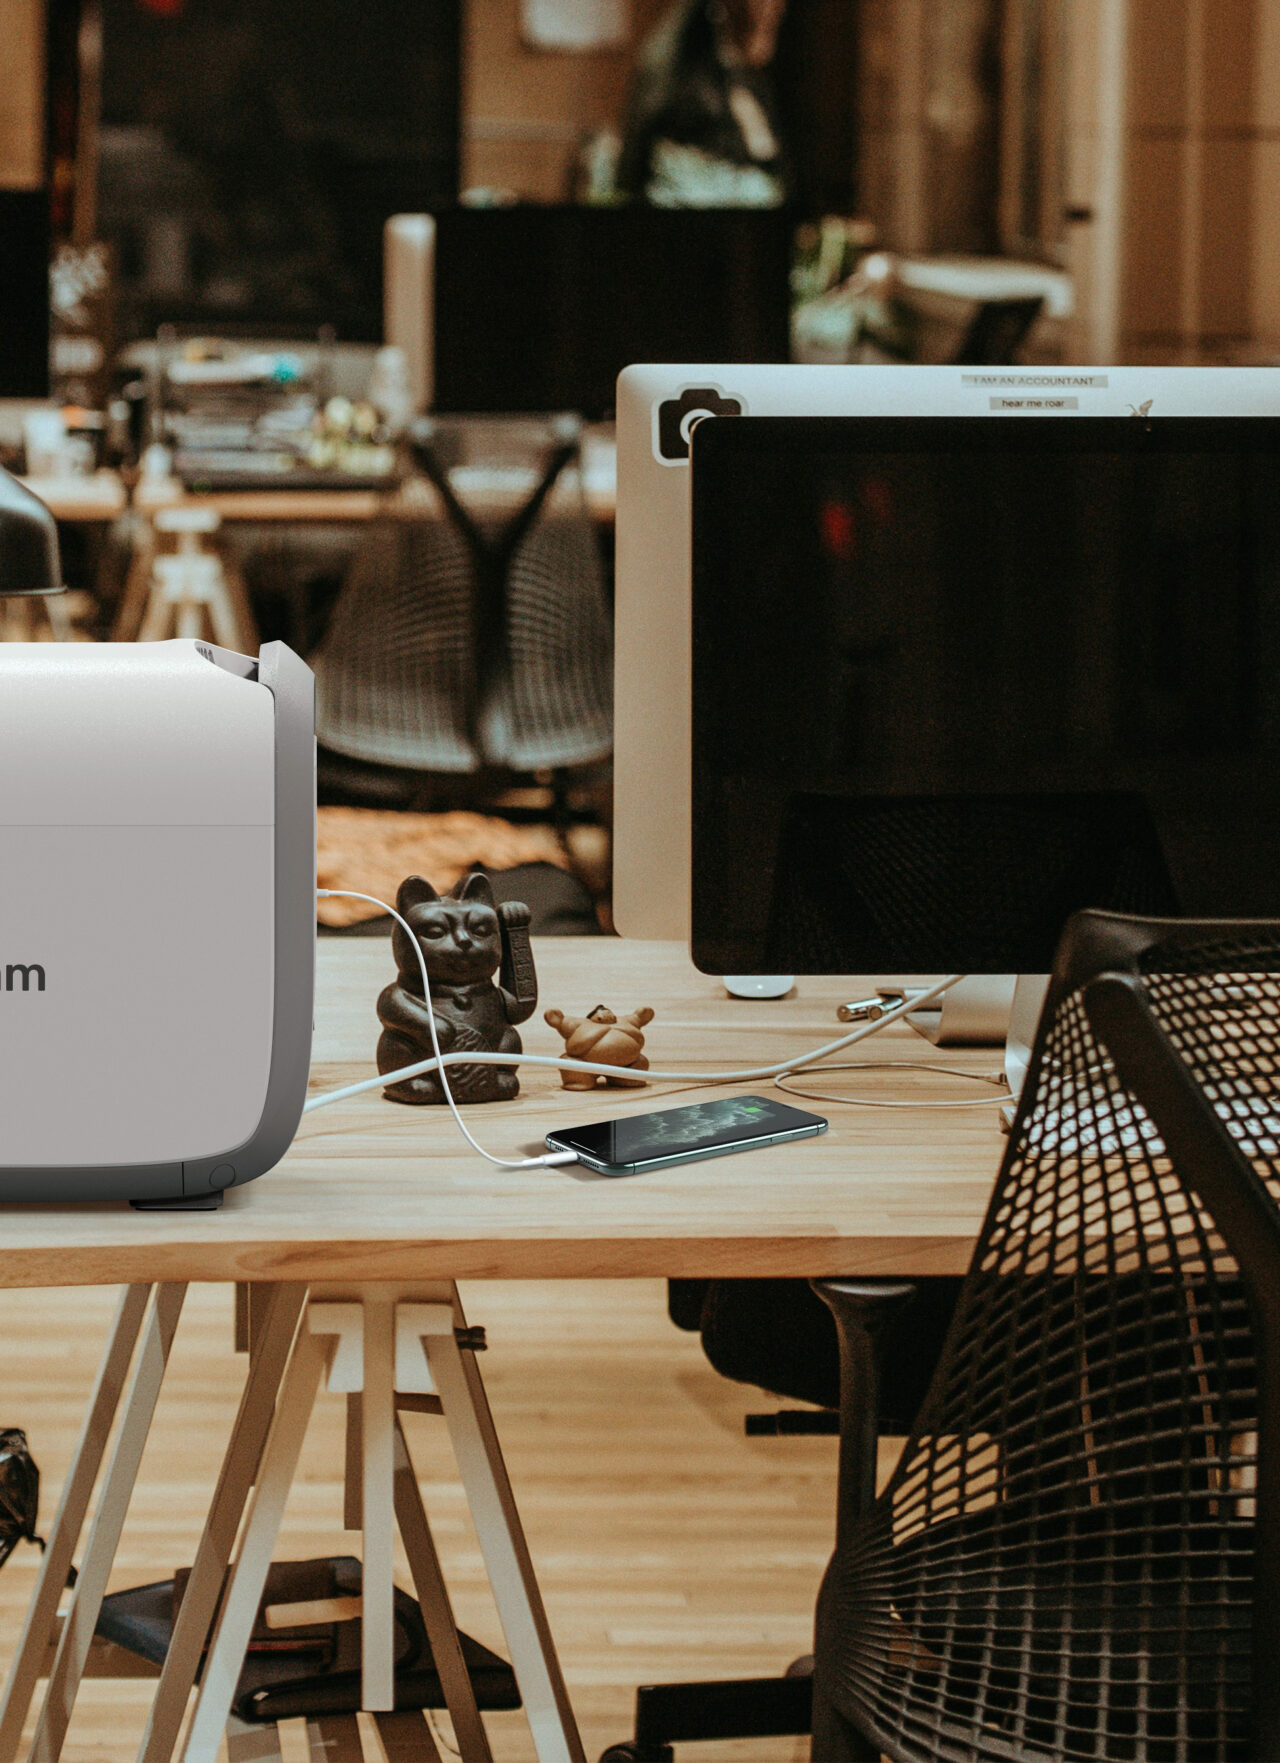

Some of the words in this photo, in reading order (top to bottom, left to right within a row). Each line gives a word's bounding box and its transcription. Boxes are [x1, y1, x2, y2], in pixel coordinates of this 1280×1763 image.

[999, 377, 1015, 385] AN
[1018, 377, 1095, 386] ACCOUNTANT
[1001, 400, 1024, 408] hear
[1026, 400, 1042, 408] me
[1044, 400, 1065, 408] roar
